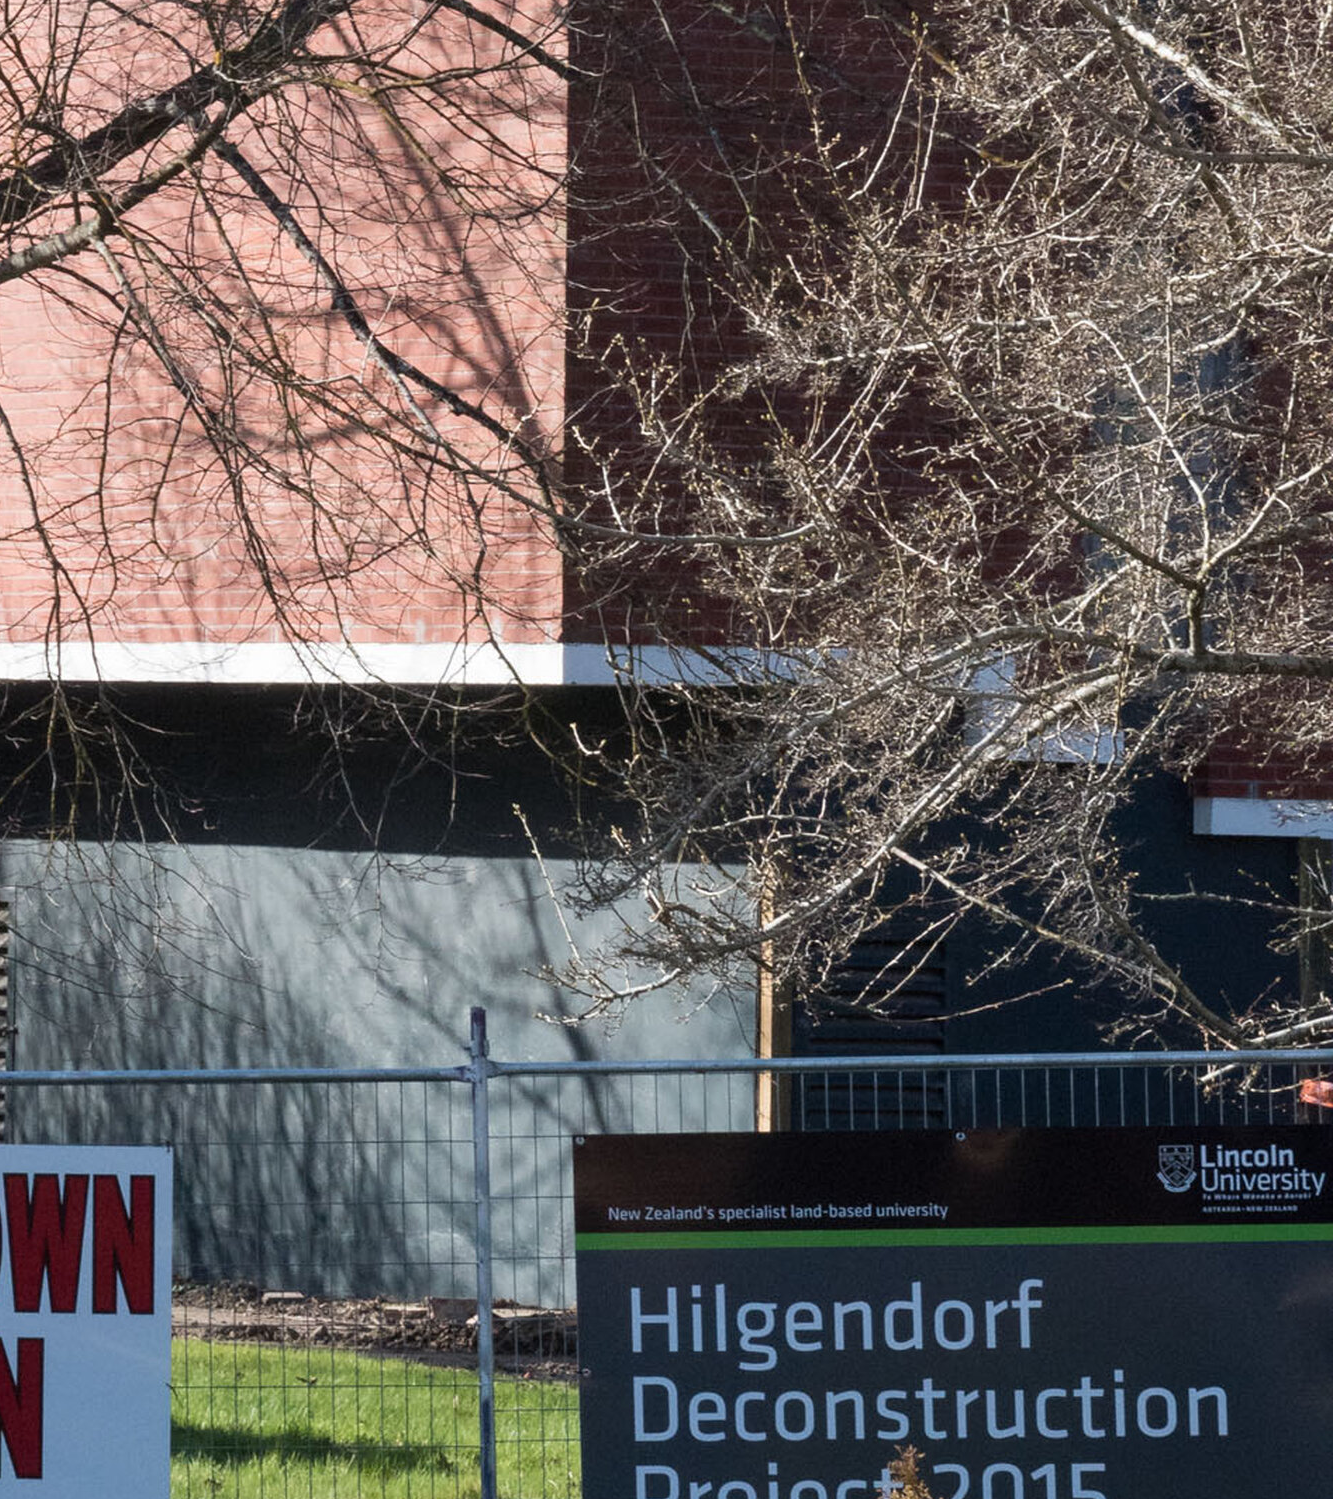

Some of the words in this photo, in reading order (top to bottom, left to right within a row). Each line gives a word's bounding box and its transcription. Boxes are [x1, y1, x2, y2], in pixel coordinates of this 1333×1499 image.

[1200, 1144, 1294, 1168] Lincoln
[1201, 1167, 1326, 1196] University
[608, 1207, 641, 1221] New
[645, 1205, 714, 1220] Zealand's
[718, 1204, 786, 1222] specialist
[790, 1204, 872, 1218] land-based
[876, 1202, 948, 1221] university
[630, 1278, 1044, 1370] Hilgendorf
[632, 1370, 1230, 1443] Deconstruction
